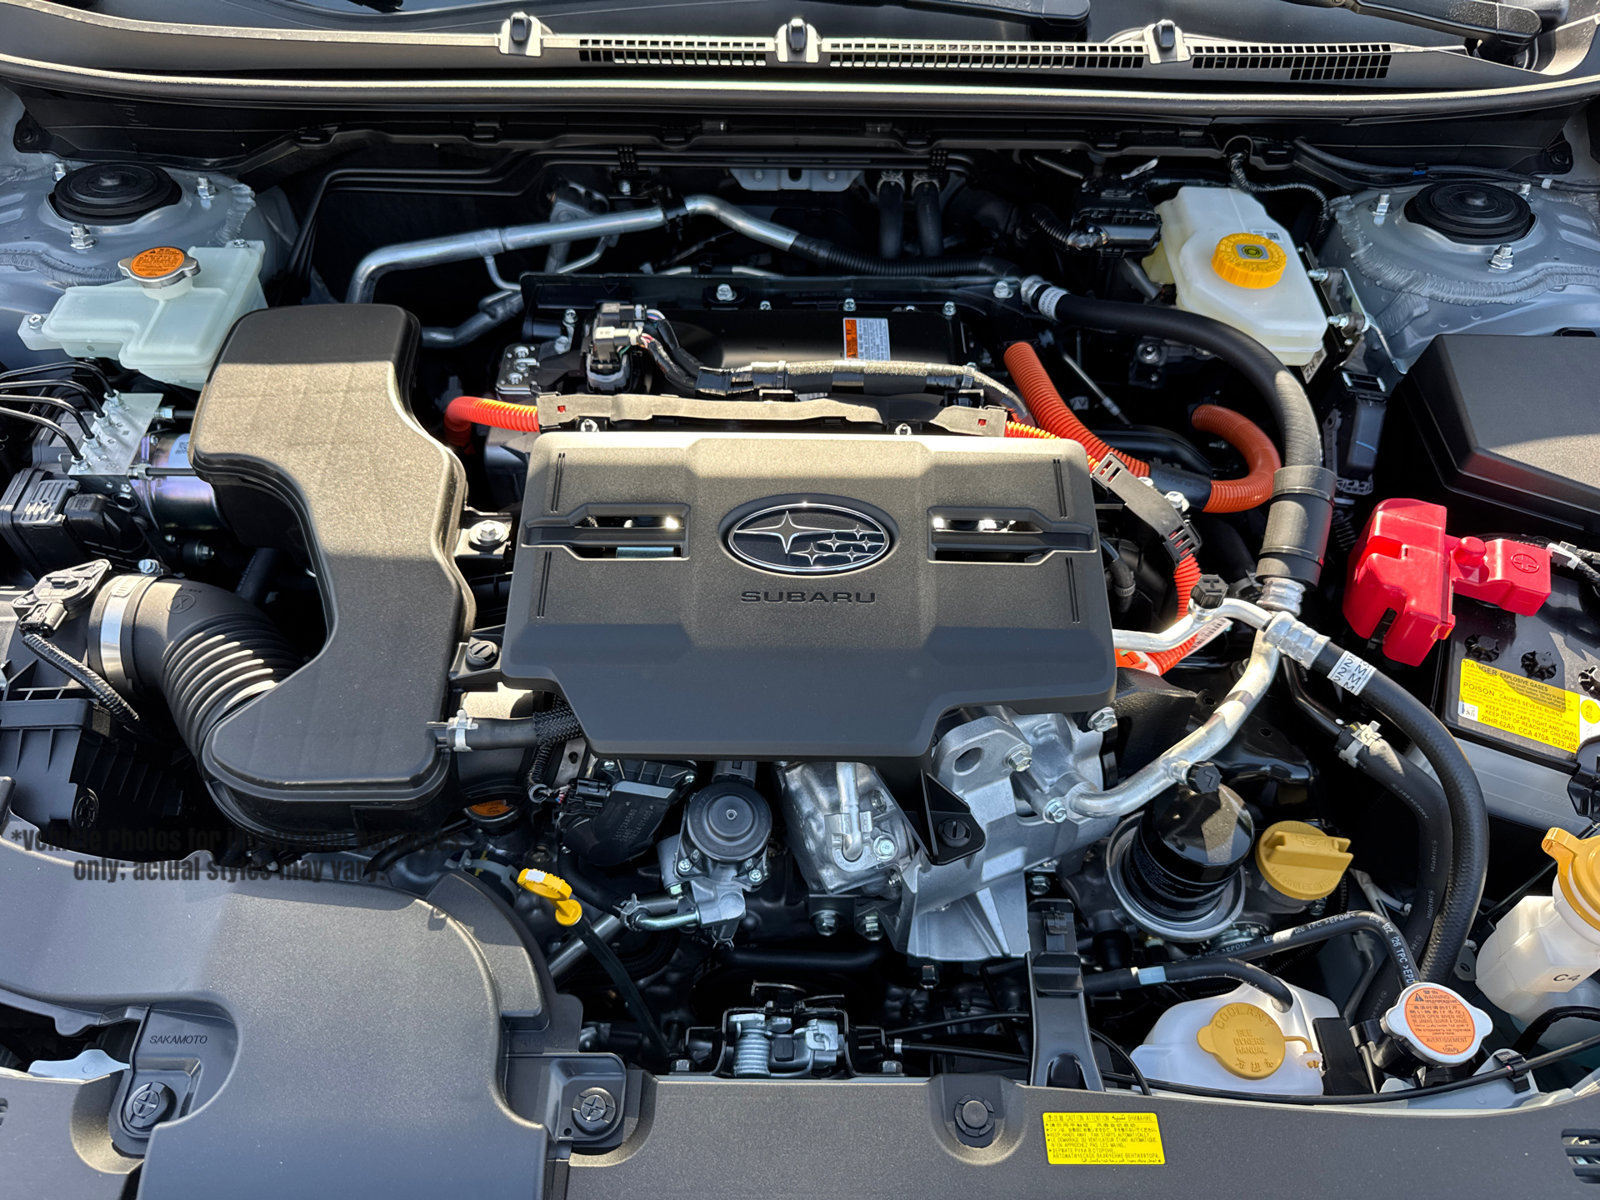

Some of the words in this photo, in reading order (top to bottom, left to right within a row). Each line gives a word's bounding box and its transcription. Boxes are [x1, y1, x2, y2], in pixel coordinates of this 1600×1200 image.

[740, 591, 875, 604] SUBARU
[1464, 660, 1498, 677] DANGER
[1463, 681, 1495, 697] POISON
[1552, 973, 1581, 982] C4
[149, 1034, 208, 1045] SAKAMOTO
